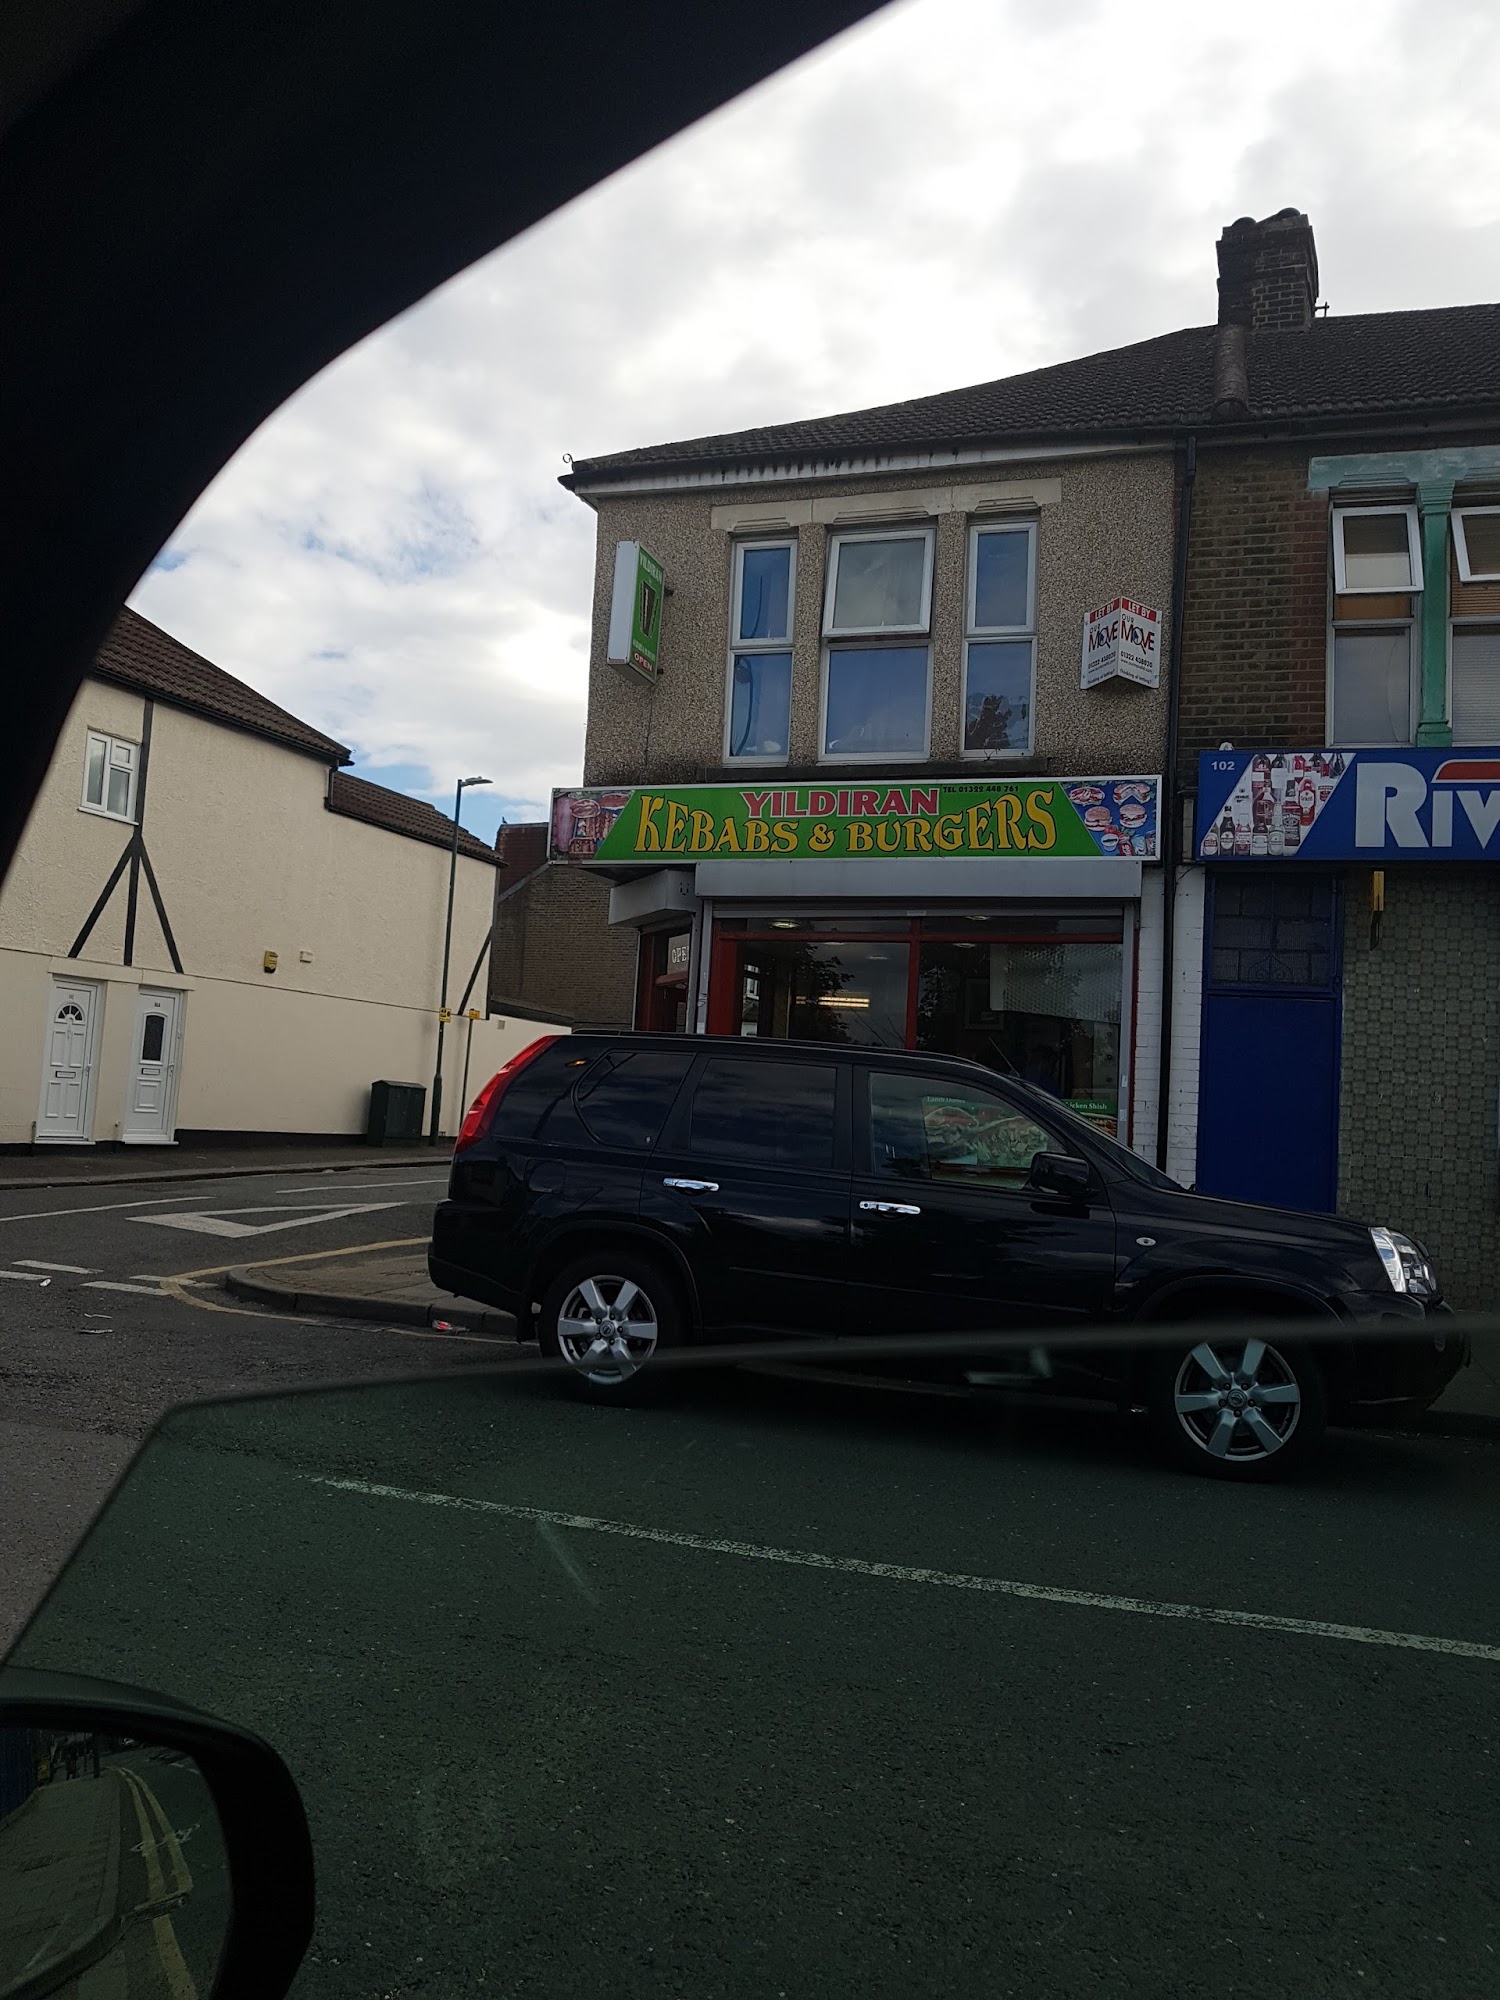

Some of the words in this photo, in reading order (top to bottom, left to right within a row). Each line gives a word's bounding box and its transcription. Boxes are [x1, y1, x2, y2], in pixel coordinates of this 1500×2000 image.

[1095, 607, 1106, 620] LET
[1106, 601, 1115, 613] BY
[1122, 613, 1134, 623] OUR
[1128, 601, 1140, 614] LET
[1141, 607, 1151, 619] BY
[1088, 620, 1119, 653] MOVE
[1121, 620, 1155, 655] MOVE
[634, 652, 653, 672] OPEN
[1211, 761, 1235, 771] 102
[958, 785, 984, 793] 01322
[1004, 784, 1019, 792] 761
[739, 788, 940, 818] YILDIRAN
[634, 793, 799, 855] KEBABS
[808, 823, 838, 852] &
[846, 785, 1058, 854] BURGERS
[1088, 1102, 1108, 1110] Shish
